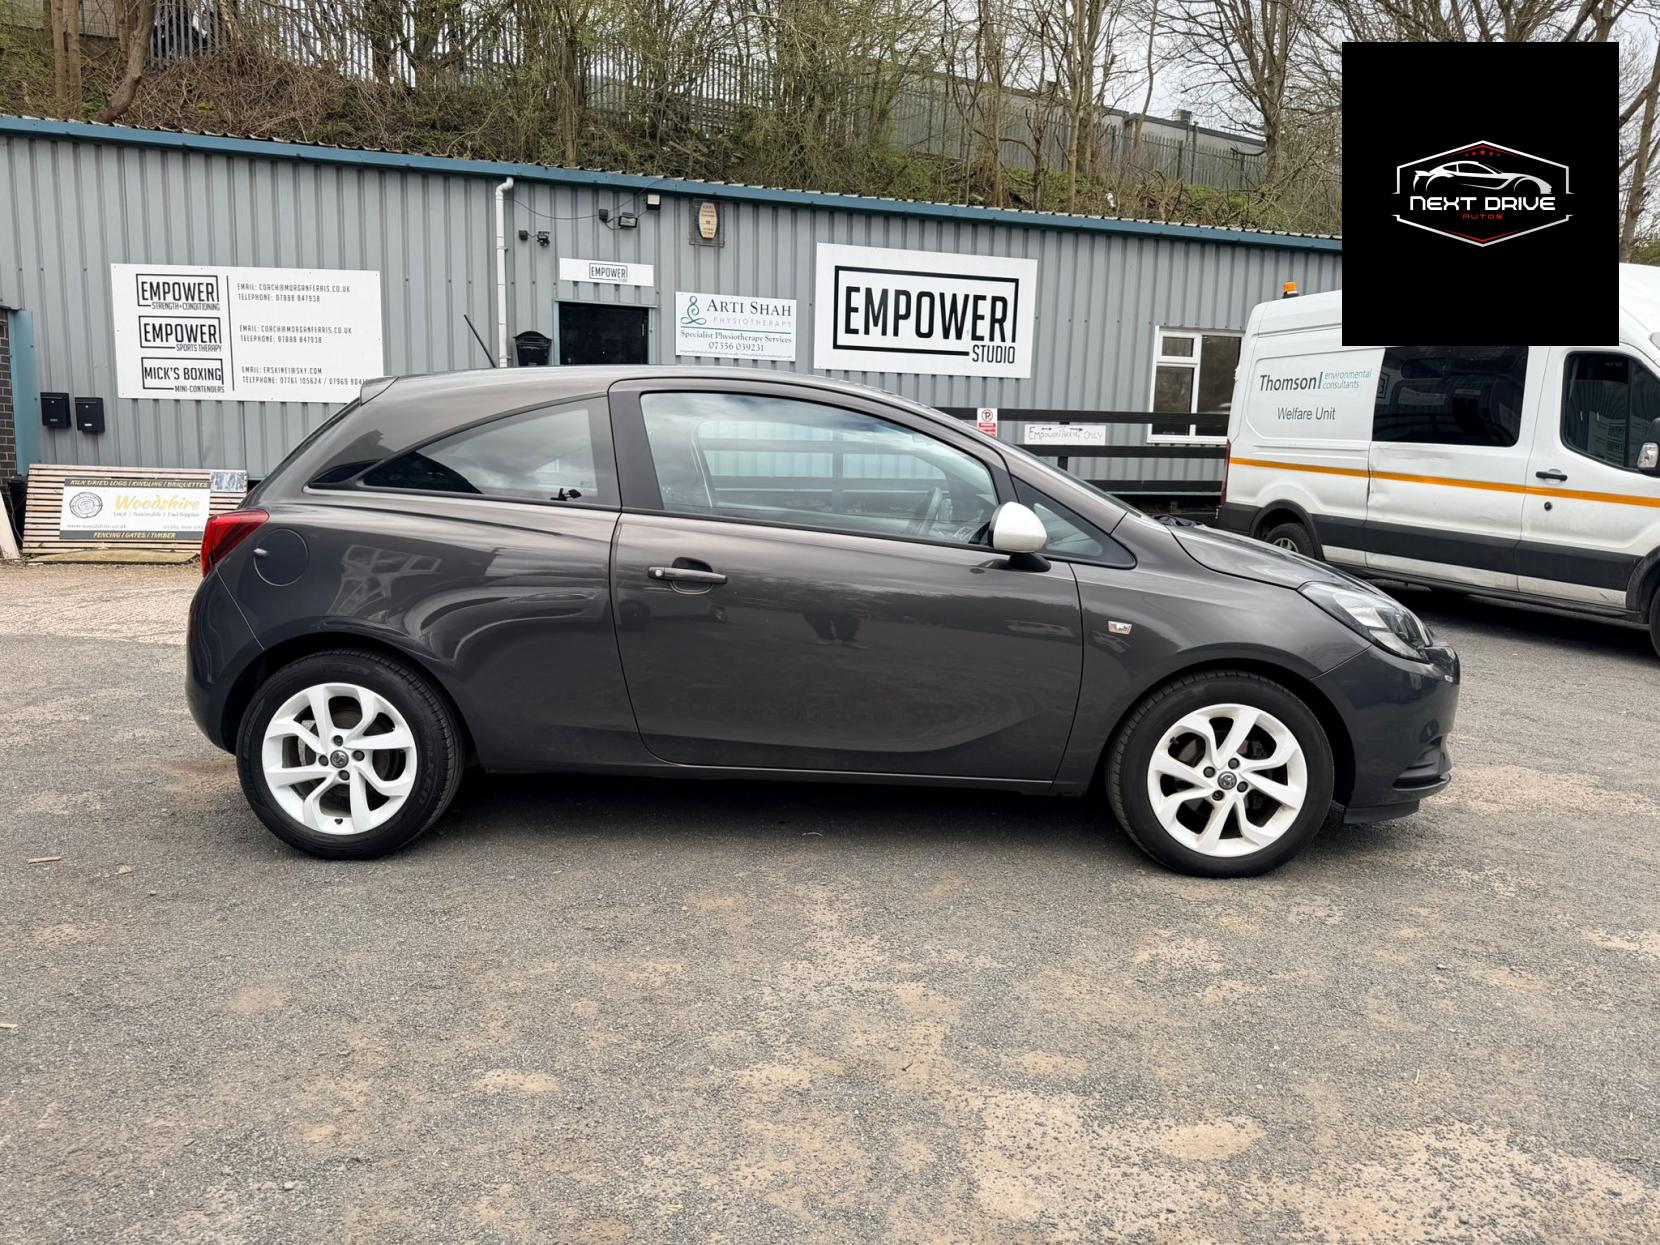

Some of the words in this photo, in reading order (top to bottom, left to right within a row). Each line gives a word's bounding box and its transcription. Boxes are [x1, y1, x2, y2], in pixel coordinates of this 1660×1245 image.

[591, 266, 626, 278] EMPOWER
[141, 281, 215, 302] EMPOWER
[237, 283, 258, 291] EMAIL:
[238, 293, 274, 301] TELEPHONE:
[706, 298, 744, 314] ARTI
[750, 301, 792, 317] SHAH
[844, 285, 1008, 343] EMPOWER
[239, 324, 260, 332] EMAIL:
[713, 316, 792, 328] PHYSIOTHERAPY
[143, 322, 217, 344] EMPOWER
[240, 335, 275, 343] TELEPHONE:
[680, 330, 713, 339] Specialist
[715, 331, 763, 342] Physiotherapy
[765, 335, 792, 343] Services
[175, 343, 197, 352] SPORTS
[198, 344, 222, 353] THERAPY
[971, 344, 1016, 364] STUDIO
[144, 366, 180, 380] MICK'S
[183, 367, 222, 381] BOXING
[241, 366, 262, 374] EMAIL:
[242, 376, 278, 384] TELEPHONE:
[1260, 374, 1317, 392] Thomson
[1324, 368, 1372, 380] environmental
[1322, 380, 1360, 389] consultants
[174, 385, 225, 393] MINI-CONTENDERS
[1277, 407, 1313, 421] Welfare
[1315, 407, 1336, 421] Unit
[115, 494, 201, 512] Woodshire
